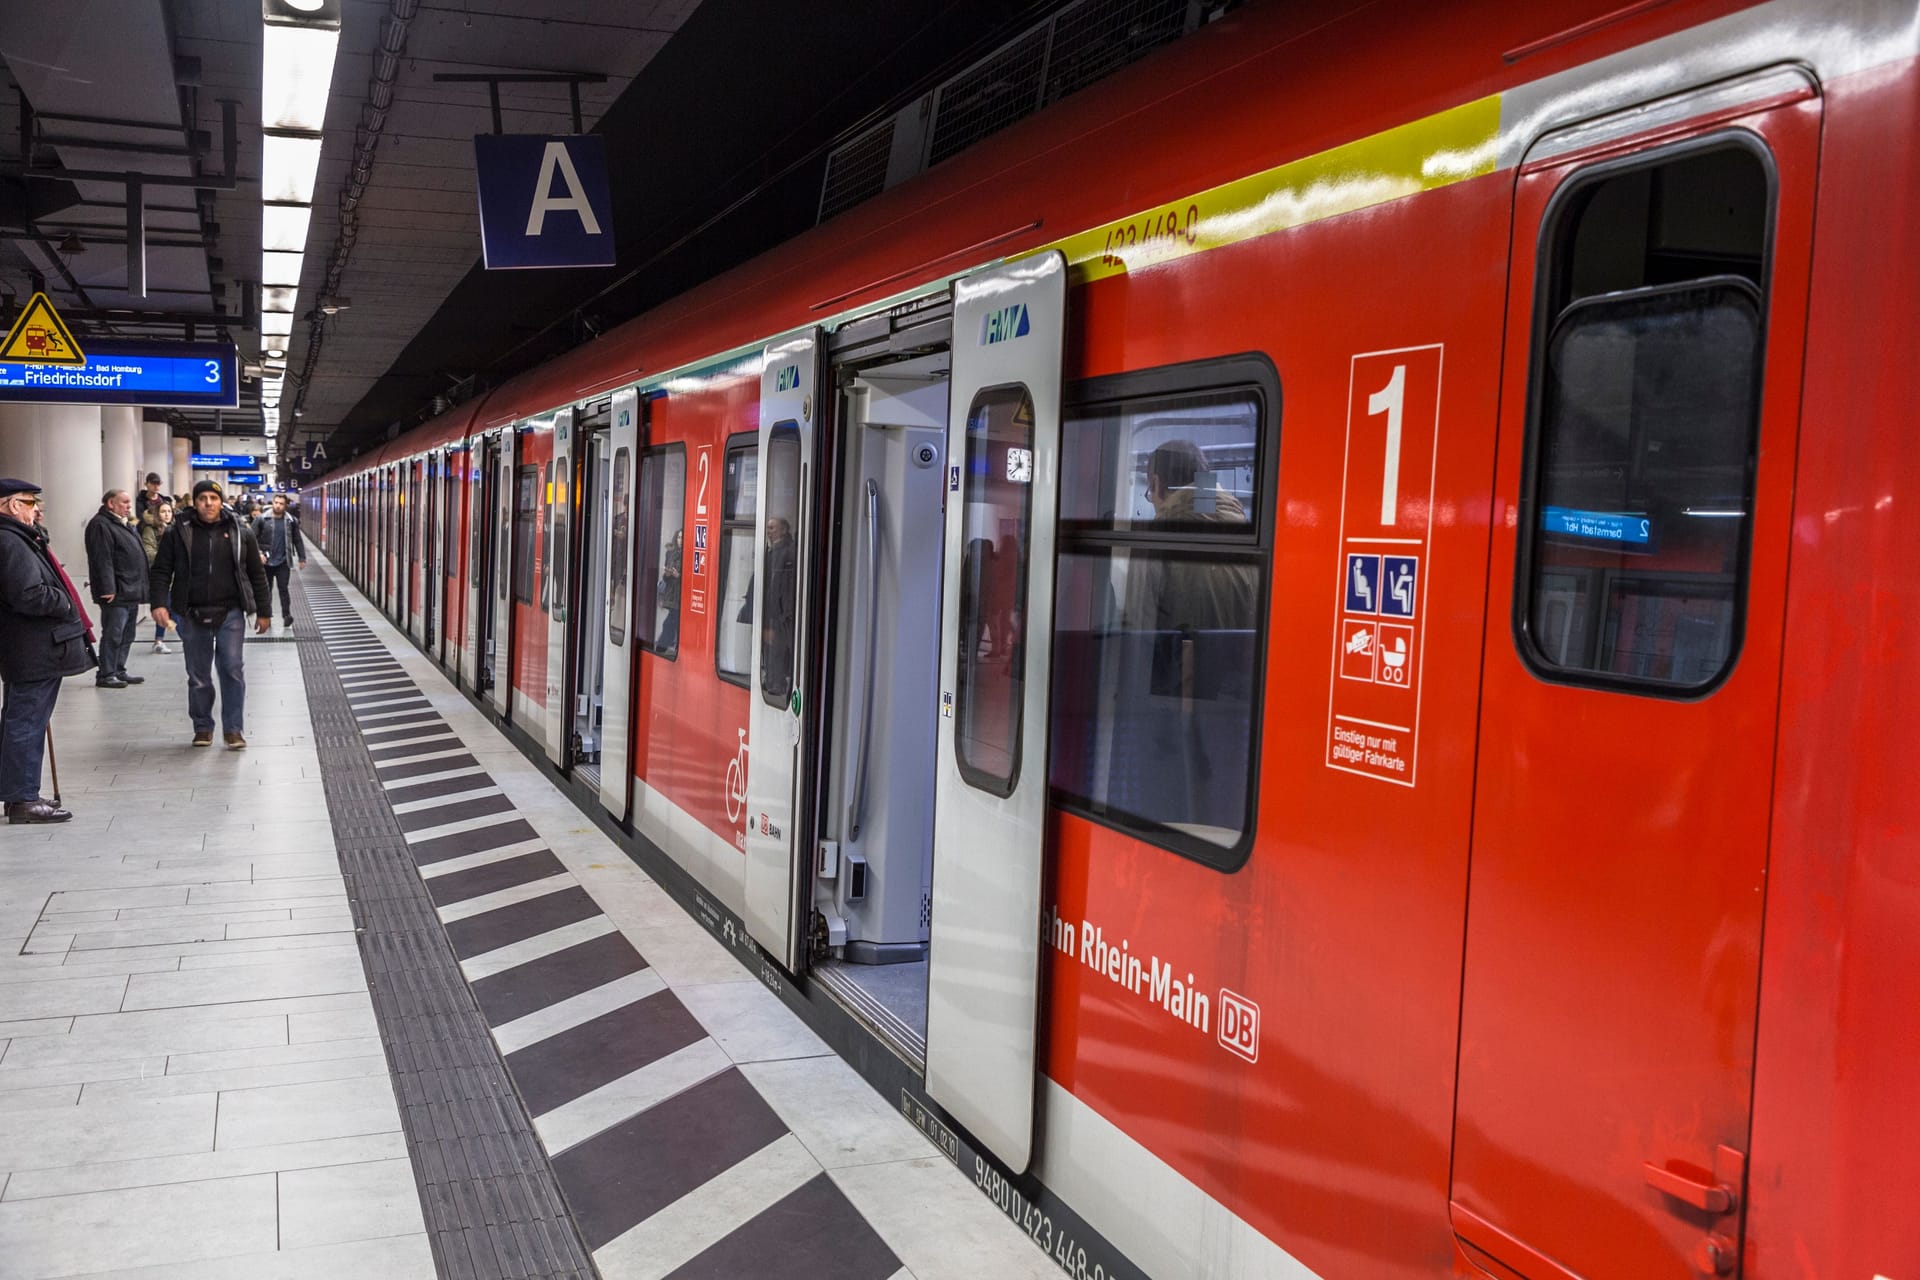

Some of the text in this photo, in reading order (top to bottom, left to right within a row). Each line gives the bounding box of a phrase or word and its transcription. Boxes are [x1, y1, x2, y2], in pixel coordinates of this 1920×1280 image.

[525, 141, 602, 236] A
[25, 371, 122, 387] Friedrichsdorf
[111, 365, 142, 375] Homburg
[204, 360, 220, 383] 3
[313, 442, 327, 459] A
[1368, 365, 1406, 526] 1
[248, 455, 255, 465] 3
[697, 451, 708, 515] 2
[1334, 726, 1397, 753] Einstieg nur mit
[1333, 744, 1405, 772] gültiger Fahrkarte
[769, 823, 782, 841] BAHN
[1080, 920, 1210, 1034] Rhein-Main
[1220, 997, 1256, 1054] DB
[1012, 1189, 1021, 1223] 0
[1024, 1202, 1052, 1253] 423
